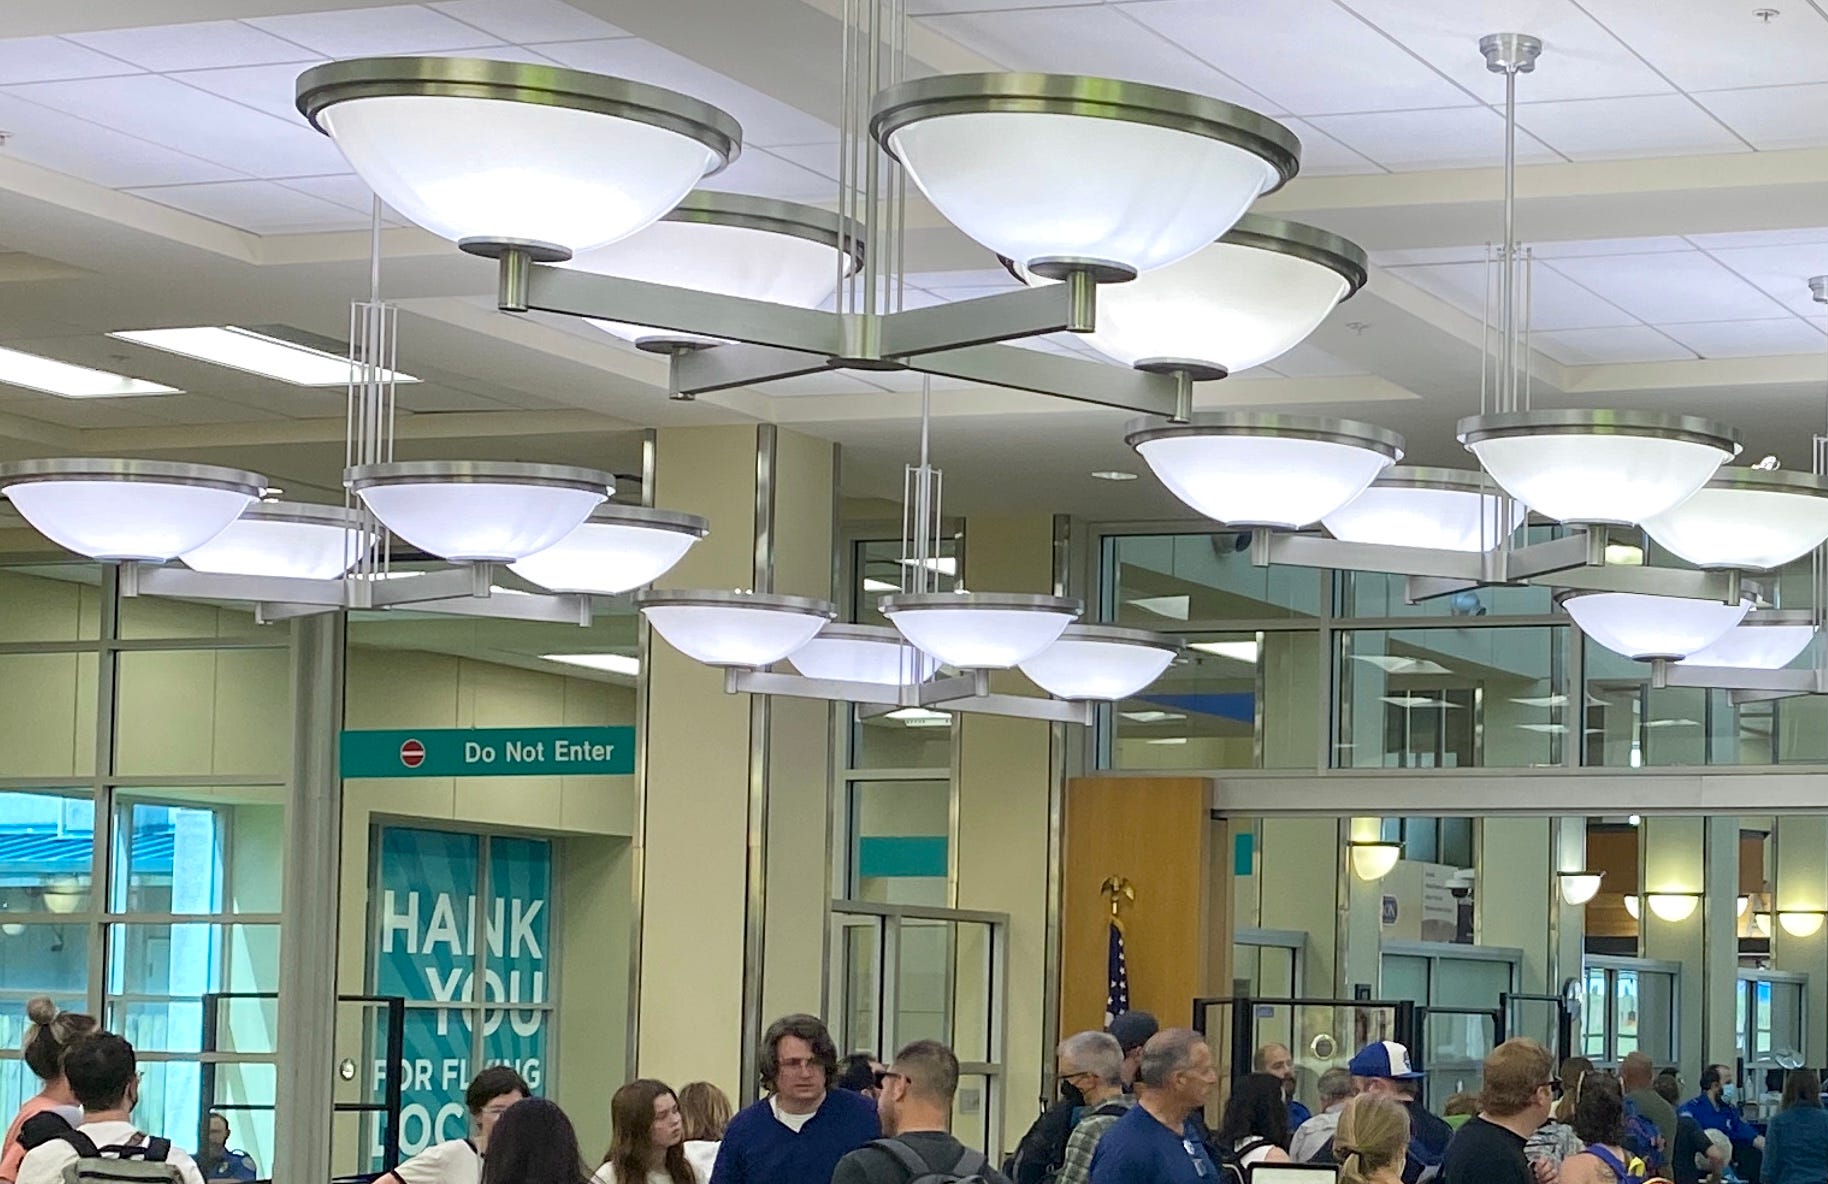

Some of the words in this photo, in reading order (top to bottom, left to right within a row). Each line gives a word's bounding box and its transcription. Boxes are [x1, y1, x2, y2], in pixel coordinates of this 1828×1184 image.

[464, 742, 496, 763] Do
[506, 741, 544, 762] Not
[555, 740, 614, 761] Enter
[425, 967, 543, 1037] YOU
